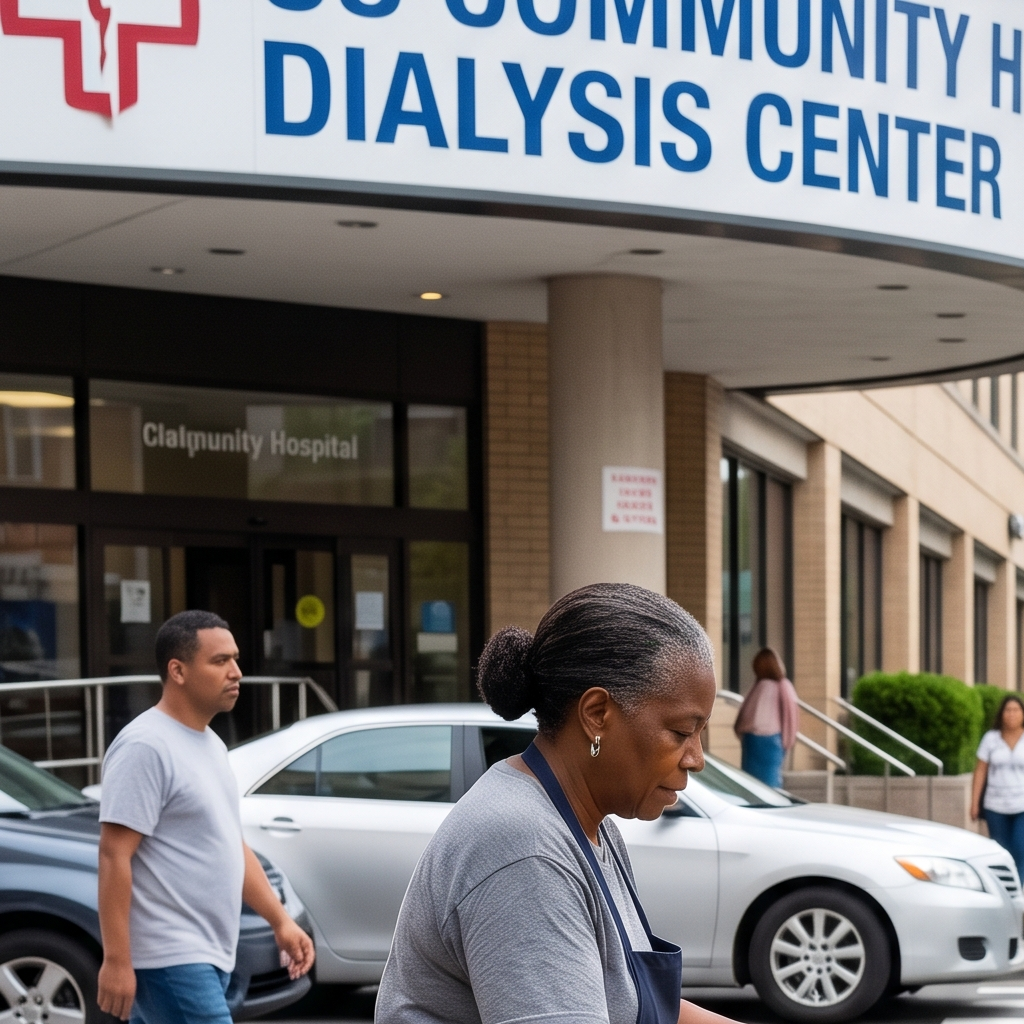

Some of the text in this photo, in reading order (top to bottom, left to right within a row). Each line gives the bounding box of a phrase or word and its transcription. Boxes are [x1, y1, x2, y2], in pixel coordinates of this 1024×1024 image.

[446, 0, 970, 98] MUNITY
[264, 40, 1002, 219] DIALYSIS CENTER
[270, 429, 358, 464] Hospital
